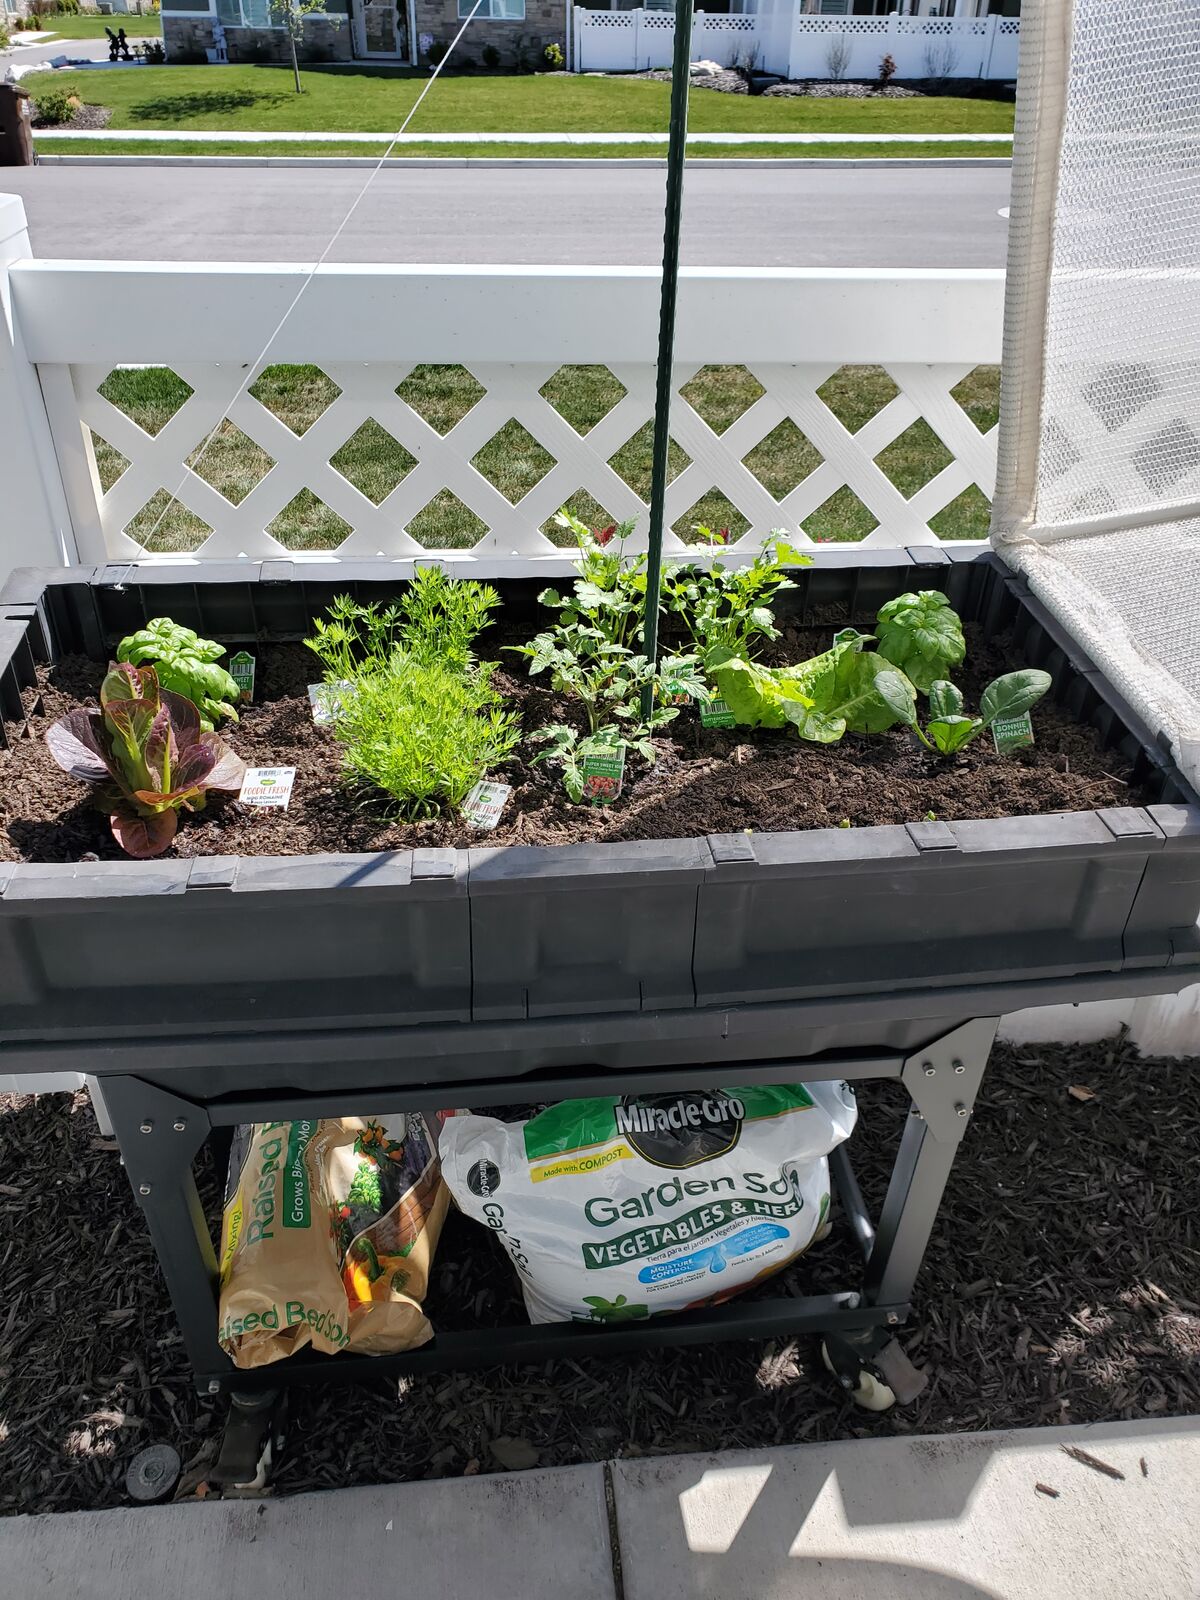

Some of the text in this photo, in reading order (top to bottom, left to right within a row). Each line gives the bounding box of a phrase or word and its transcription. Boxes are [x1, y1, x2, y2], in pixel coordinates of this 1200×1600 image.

[996, 721, 1027, 733] BONNIE
[996, 727, 1030, 740] SPINACH
[243, 786, 290, 795] FOODIE FRESH
[615, 1098, 745, 1135] Miracle-Gro
[543, 1148, 624, 1177] Made with COMPOST
[247, 1137, 283, 1246] Raised
[291, 1181, 304, 1223] Grows
[584, 1176, 736, 1228] Garden
[588, 1204, 726, 1264] VEGETABLES
[731, 1201, 749, 1215] &
[647, 1253, 667, 1263] Tierra
[666, 1247, 683, 1260] para
[683, 1243, 691, 1252] el
[714, 1219, 745, 1238] Vegetales
[744, 1217, 751, 1225] y
[650, 1259, 694, 1275] MOISTURE
[651, 1265, 692, 1281] CONTROL
[285, 1300, 331, 1334] Bed
